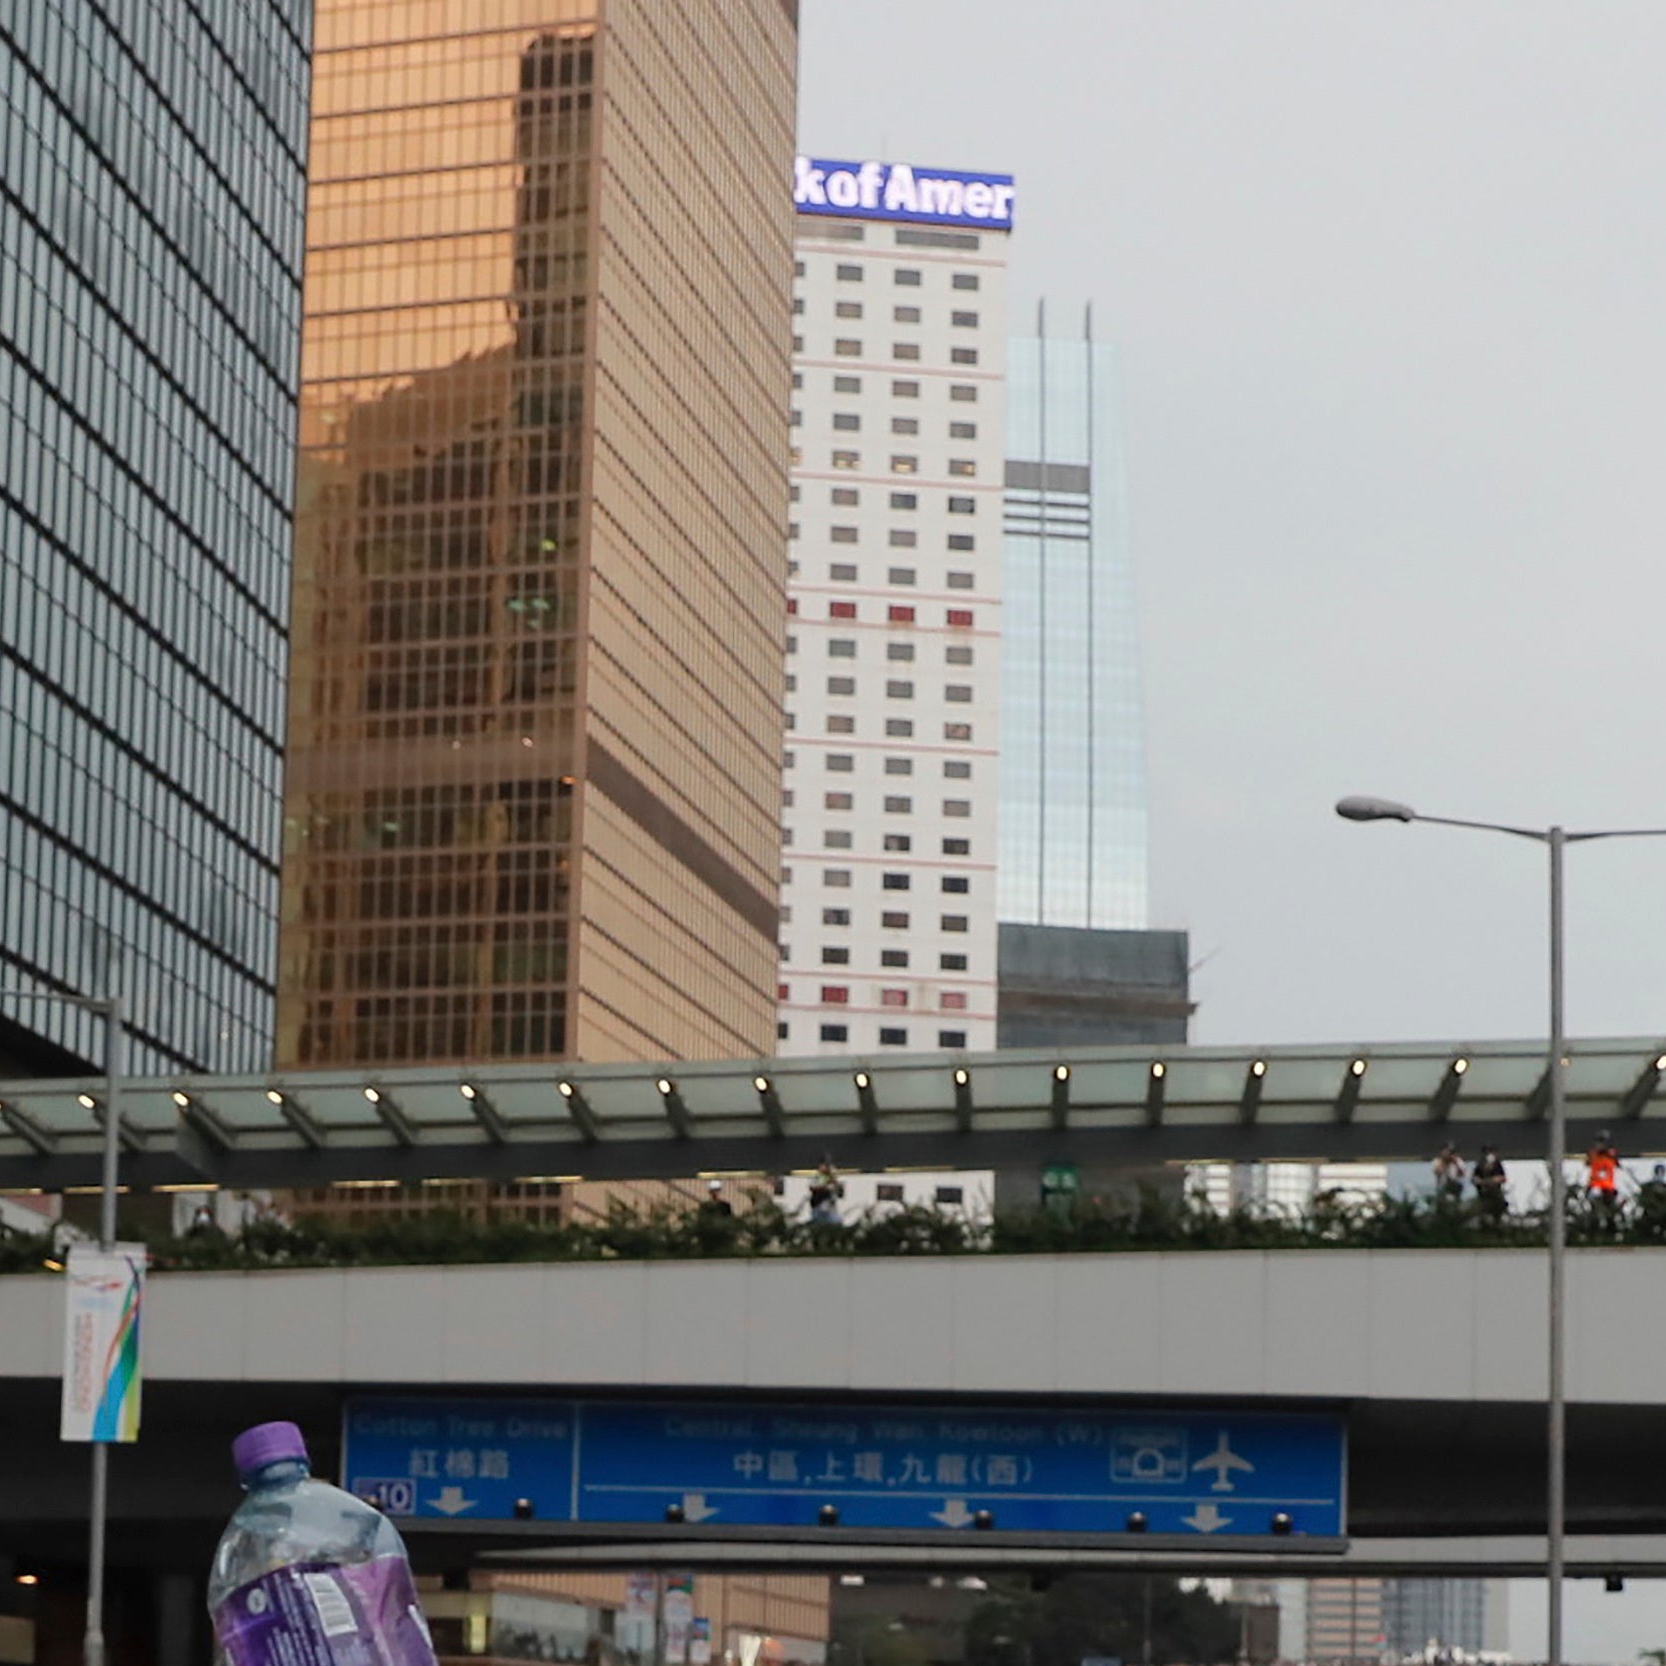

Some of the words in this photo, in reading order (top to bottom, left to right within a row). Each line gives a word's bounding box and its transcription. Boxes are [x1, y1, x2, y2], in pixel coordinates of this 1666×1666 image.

[826, 161, 883, 209] of
[885, 164, 1016, 219] Amer
[354, 1414, 435, 1437] Cotton
[446, 1416, 496, 1437] Tree
[507, 1416, 568, 1439] Drive
[771, 1418, 860, 1444] Sheung
[938, 1423, 1044, 1444] Kowloon
[1055, 1424, 1104, 1448] (W)
[409, 1448, 511, 1479] 紅棉路
